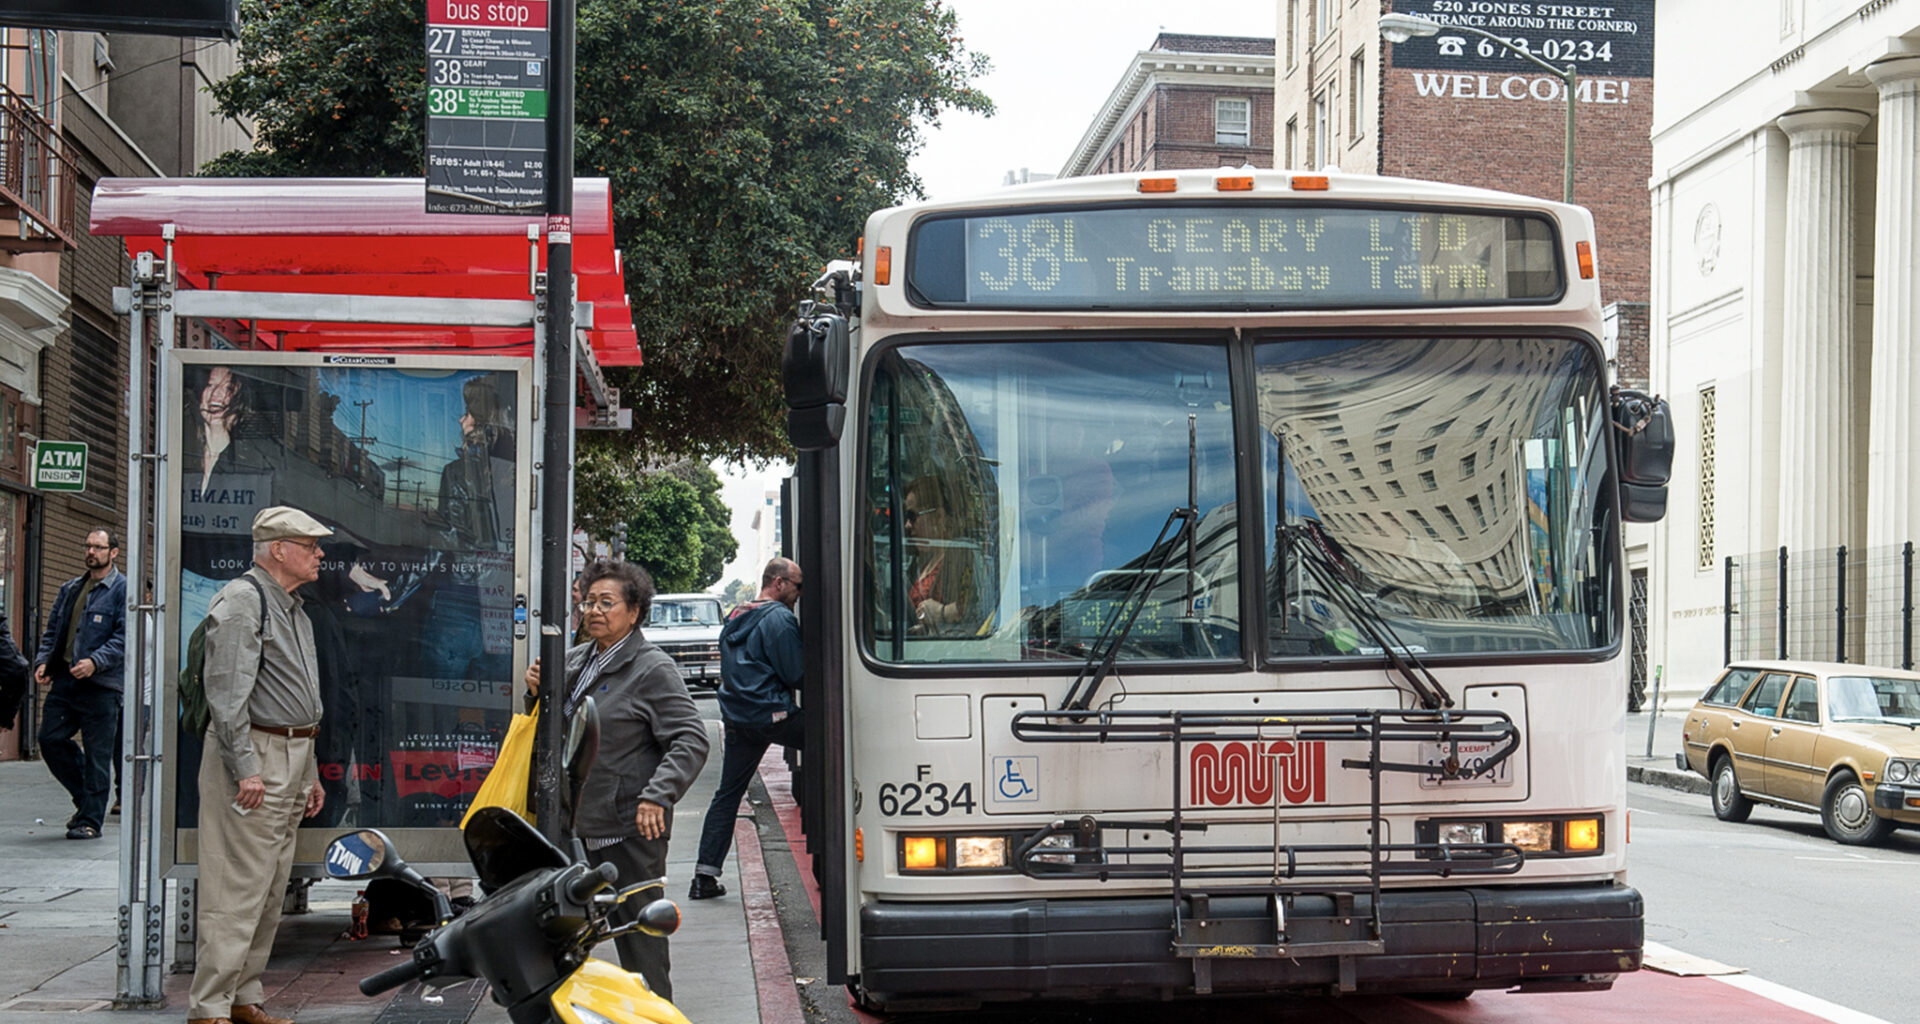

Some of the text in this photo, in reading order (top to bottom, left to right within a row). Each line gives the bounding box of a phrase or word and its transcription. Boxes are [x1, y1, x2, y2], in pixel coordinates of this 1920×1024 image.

[447, 0, 529, 26] bus stop
[1432, 1, 1615, 18] 520 JONES STREET
[1412, 13, 1638, 35] ENTRANCE AROUND THE CORNER)
[428, 28, 456, 54] 27
[1477, 37, 1613, 62] 673-0234
[434, 59, 461, 84] 38
[468, 89, 525, 98] GEARY LIMITED
[1412, 73, 1630, 104] WELCOME!
[429, 88, 466, 113] 38L
[429, 155, 462, 166] Fares:
[428, 203, 449, 211] Info:
[449, 204, 496, 213] 673-MUNI
[1148, 217, 1467, 252] GEARY LTD
[1106, 255, 1496, 291] Transbay Term.
[41, 450, 82, 467] ATM
[211, 559, 244, 569] LOOK
[319, 561, 345, 571] OUR
[381, 562, 396, 571] TO
[401, 563, 447, 573] WHAT'S
[1458, 745, 1490, 753] EXEMPT
[351, 763, 382, 780] IN
[917, 764, 931, 782] F
[878, 782, 977, 817] 6234
